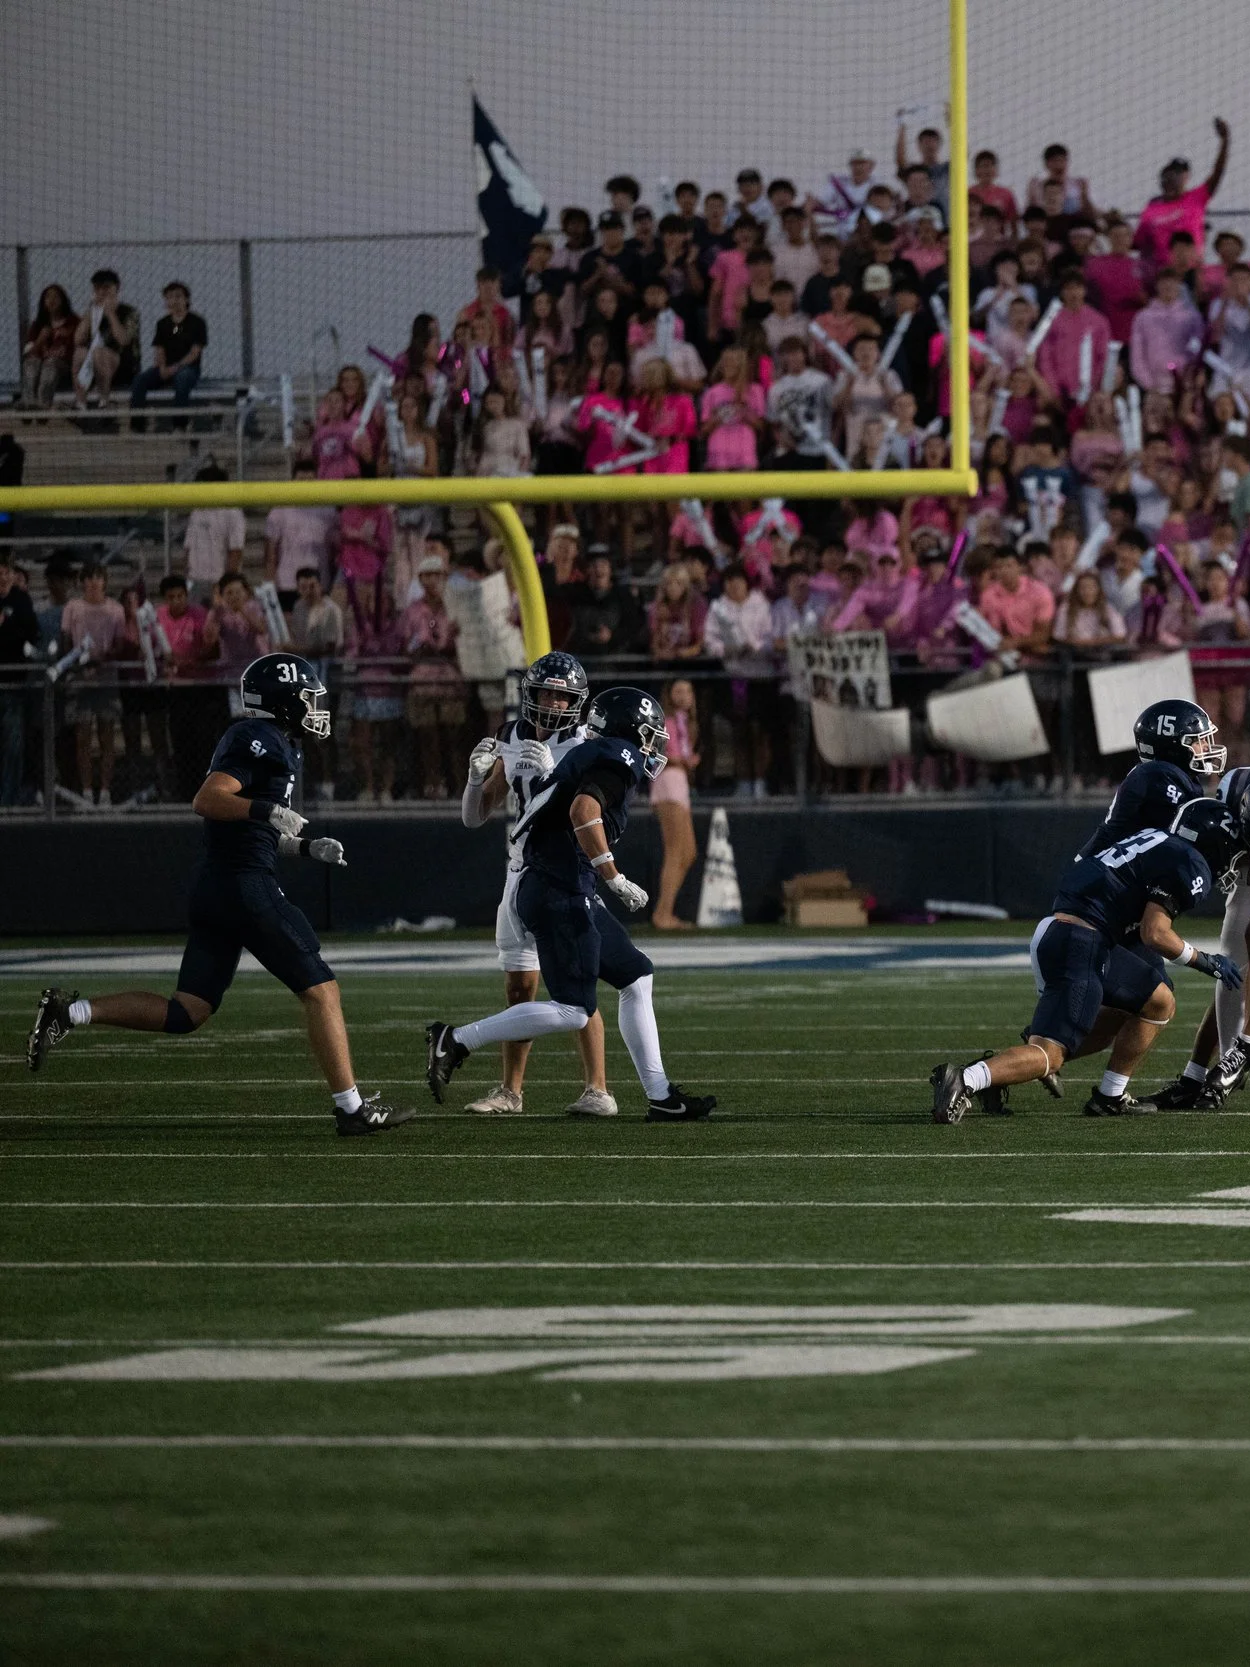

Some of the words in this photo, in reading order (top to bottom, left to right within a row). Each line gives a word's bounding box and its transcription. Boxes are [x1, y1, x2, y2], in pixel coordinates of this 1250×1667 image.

[276, 663, 298, 682] 31
[638, 698, 654, 716] 9
[1156, 715, 1176, 736] 15
[1165, 784, 1182, 804] SV
[14, 1302, 1192, 1383] 50
